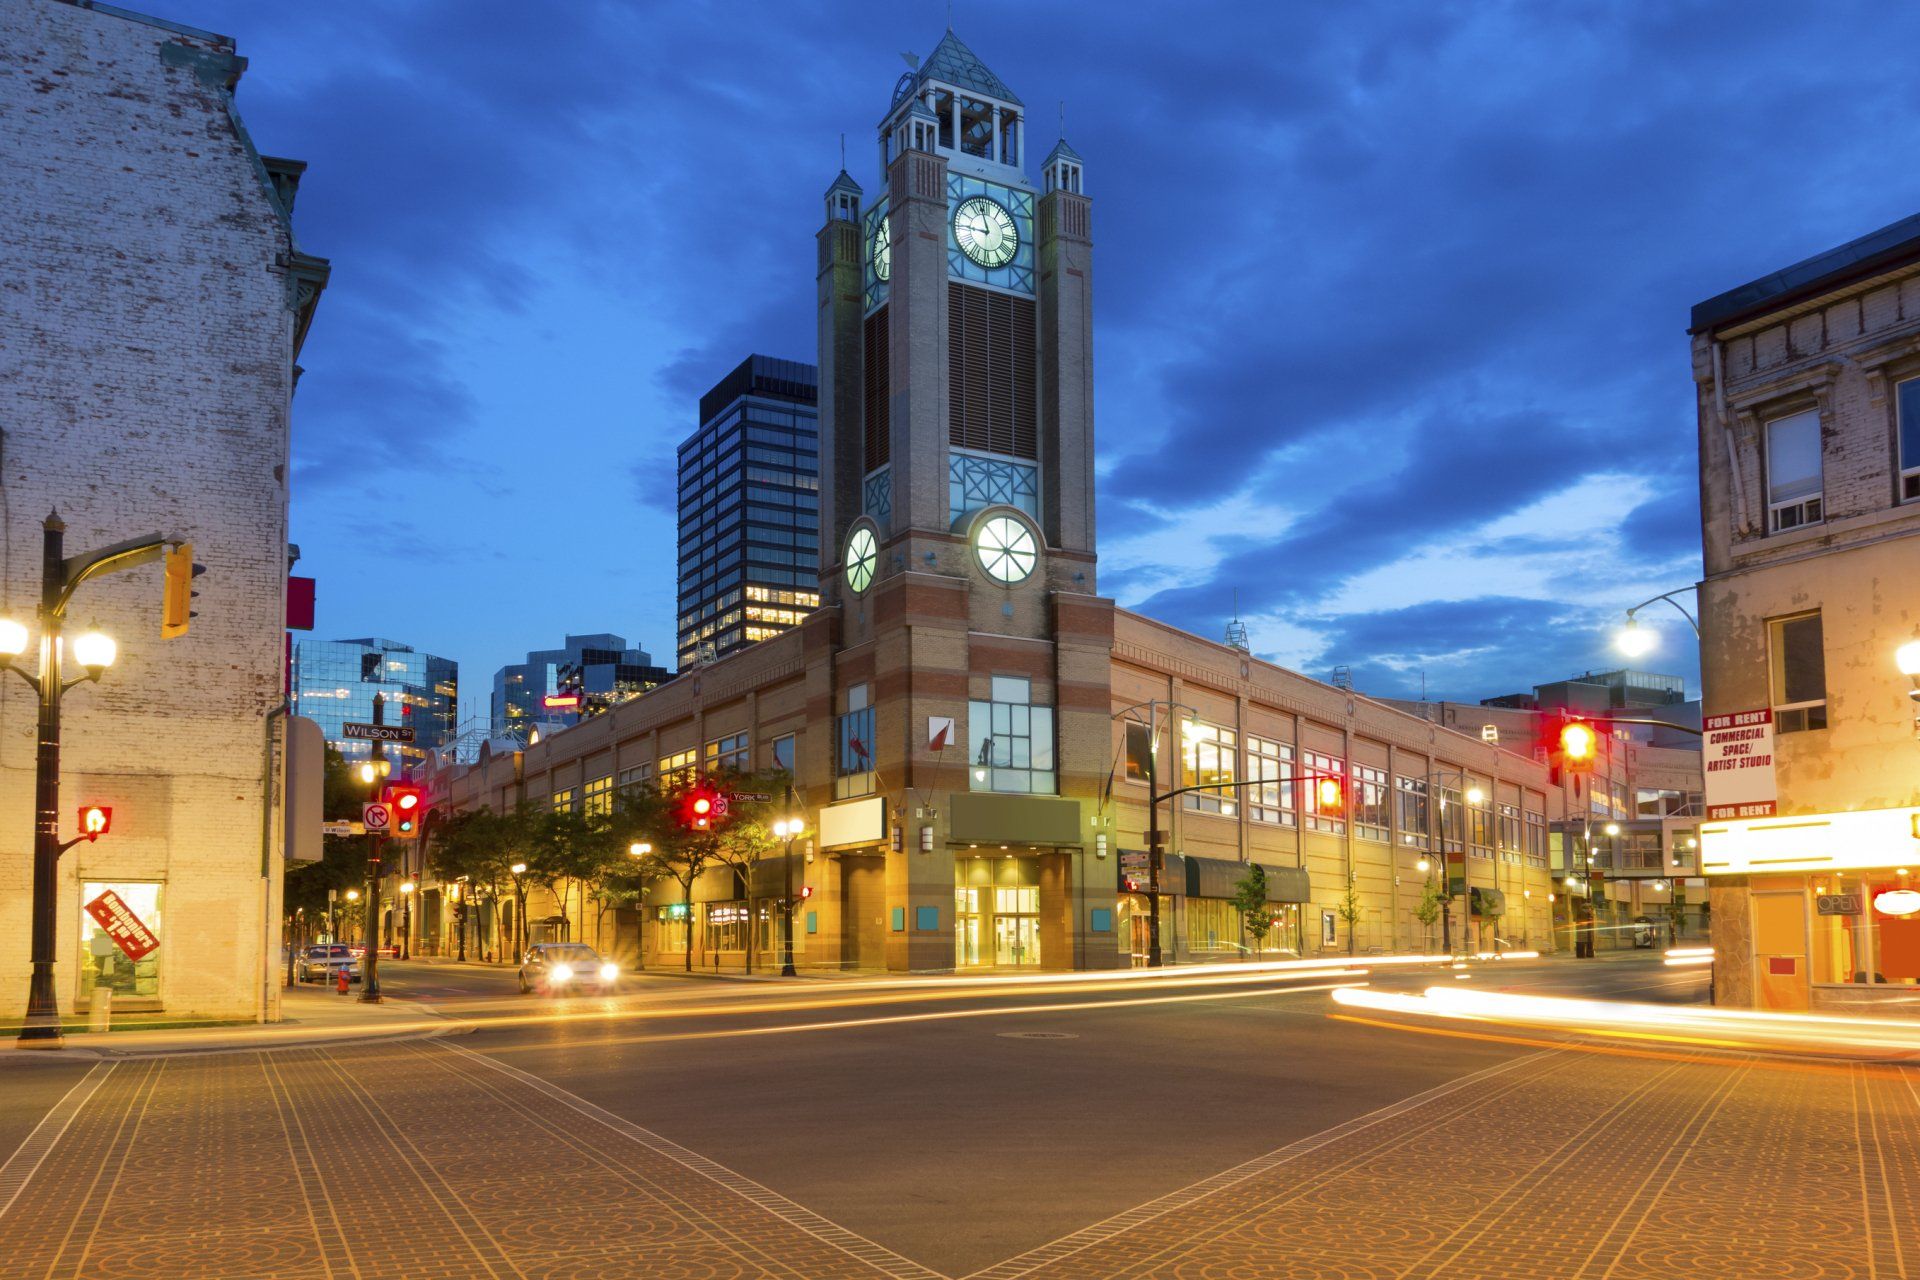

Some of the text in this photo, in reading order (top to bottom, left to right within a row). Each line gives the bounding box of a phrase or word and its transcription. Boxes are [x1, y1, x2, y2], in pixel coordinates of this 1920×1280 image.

[1707, 711, 1766, 729] FOR RENT
[346, 725, 412, 739] WILSON ST
[1710, 728, 1764, 744] COMMERCIAL
[1722, 742, 1754, 756] SPACE/
[1707, 754, 1771, 772] ARTIST STUDIO
[733, 792, 755, 801] YORK
[1711, 803, 1771, 819] FOR RENT
[1818, 896, 1861, 911] OPEN
